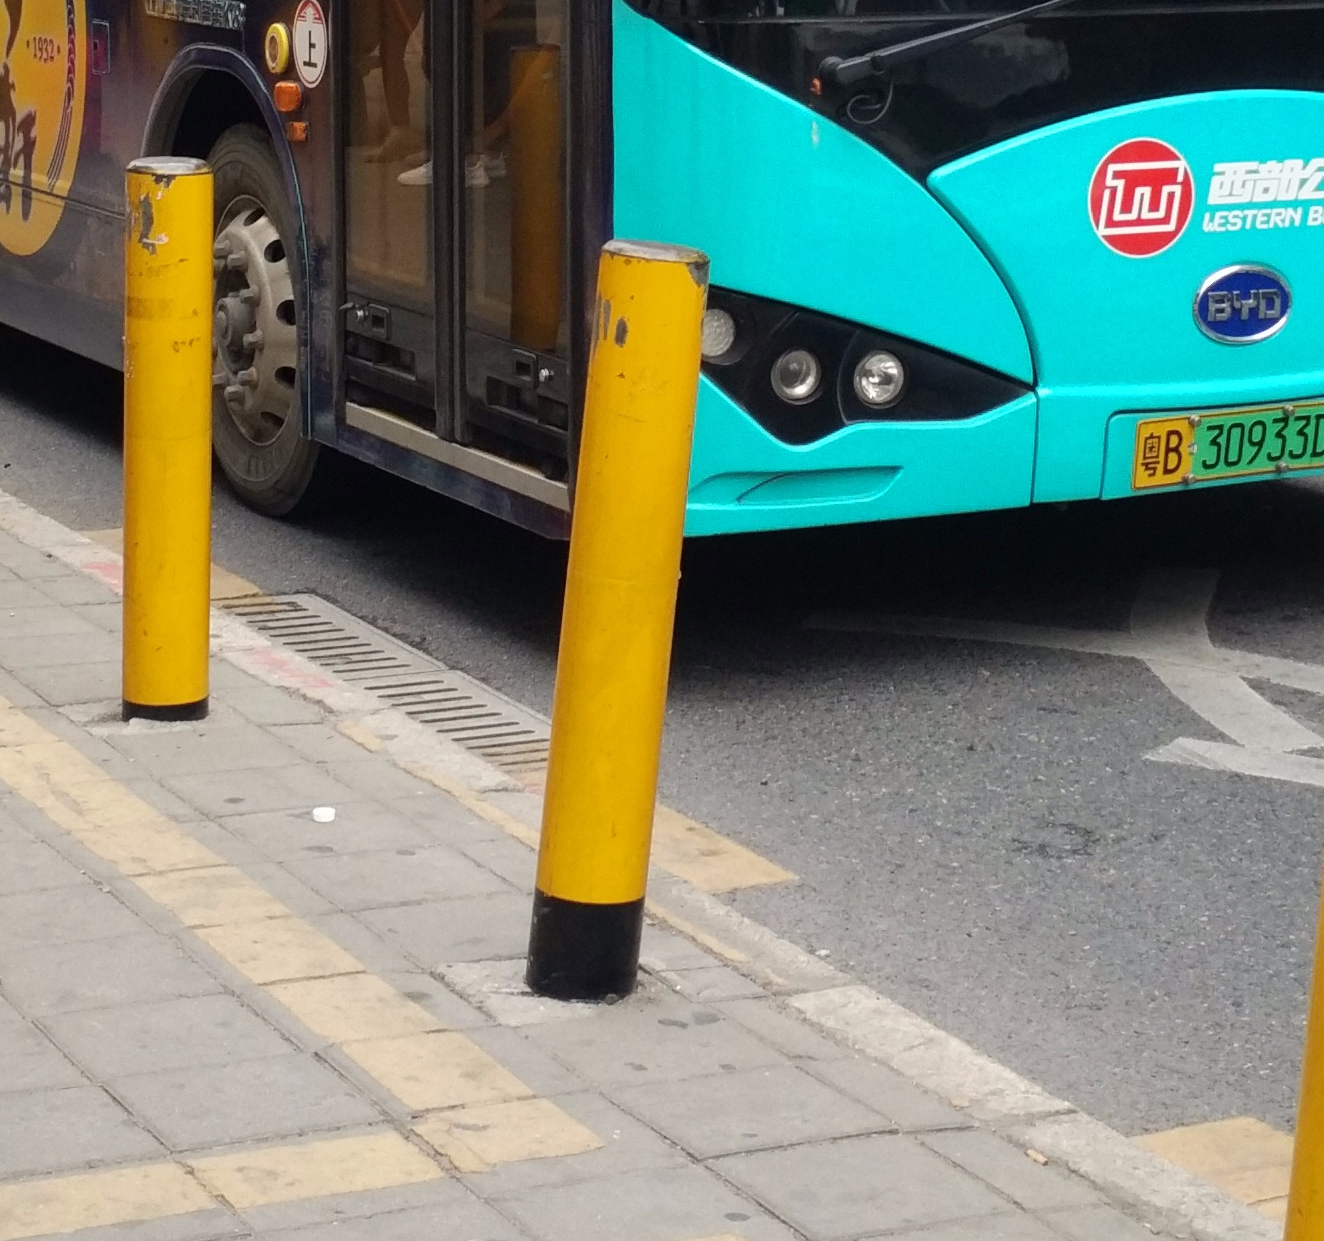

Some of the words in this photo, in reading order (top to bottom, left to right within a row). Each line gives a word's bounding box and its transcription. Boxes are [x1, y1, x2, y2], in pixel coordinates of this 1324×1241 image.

[32, 35, 56, 63] 1932
[302, 30, 319, 69] 上
[1202, 207, 1303, 233] WESTERN
[1206, 288, 1283, 323] BYD
[1142, 428, 1184, 478] 粤B
